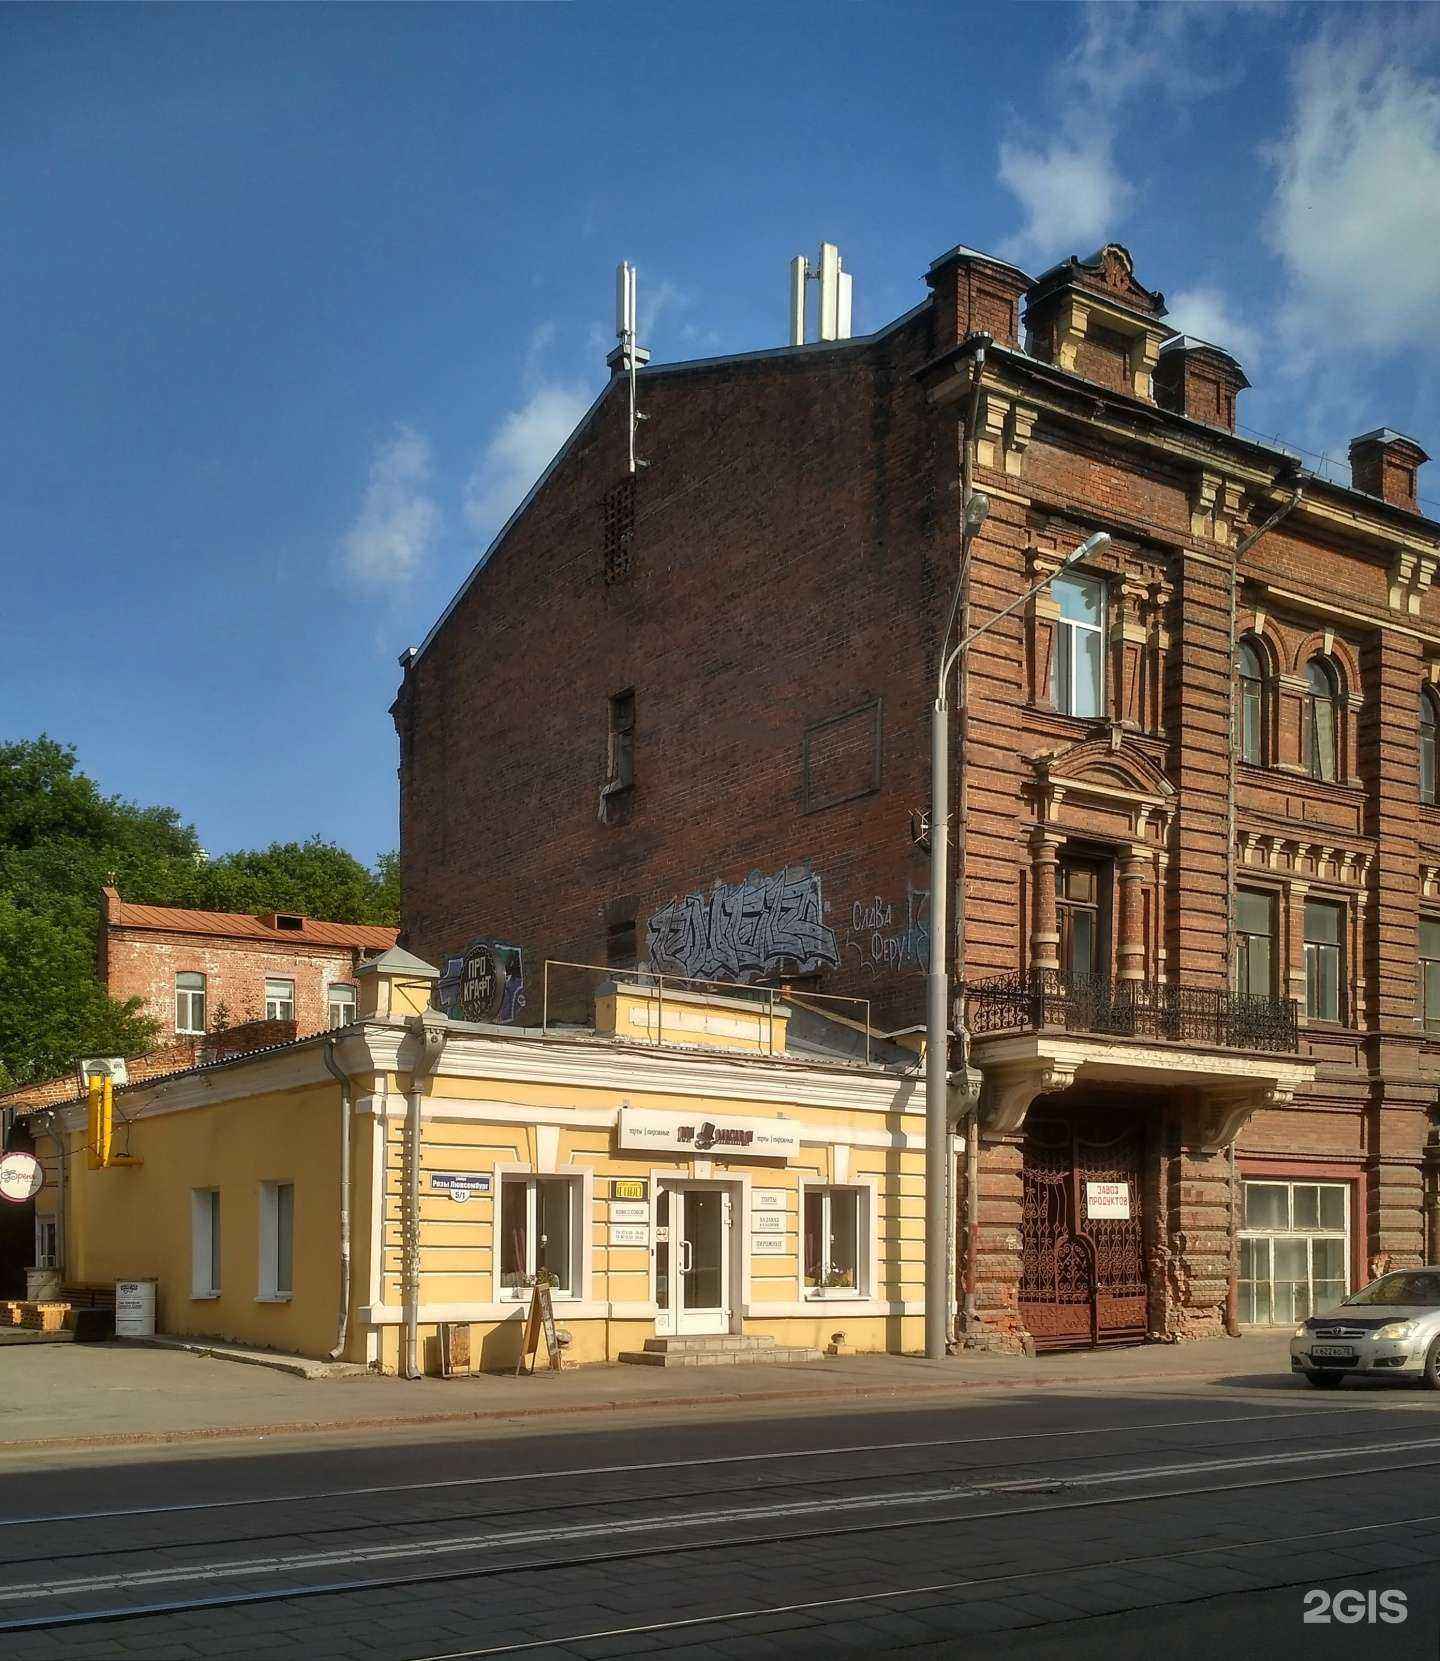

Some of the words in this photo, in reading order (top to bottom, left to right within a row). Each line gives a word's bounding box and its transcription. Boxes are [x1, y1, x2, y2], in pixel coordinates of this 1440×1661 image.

[468, 956, 486, 979] ПРО
[463, 975, 492, 1002] КРАФТ
[432, 1179, 450, 1188] Розы
[1096, 1185, 1119, 1195] ЗАВОЗ
[1088, 1196, 1128, 1206] ПРОДУКТОВ
